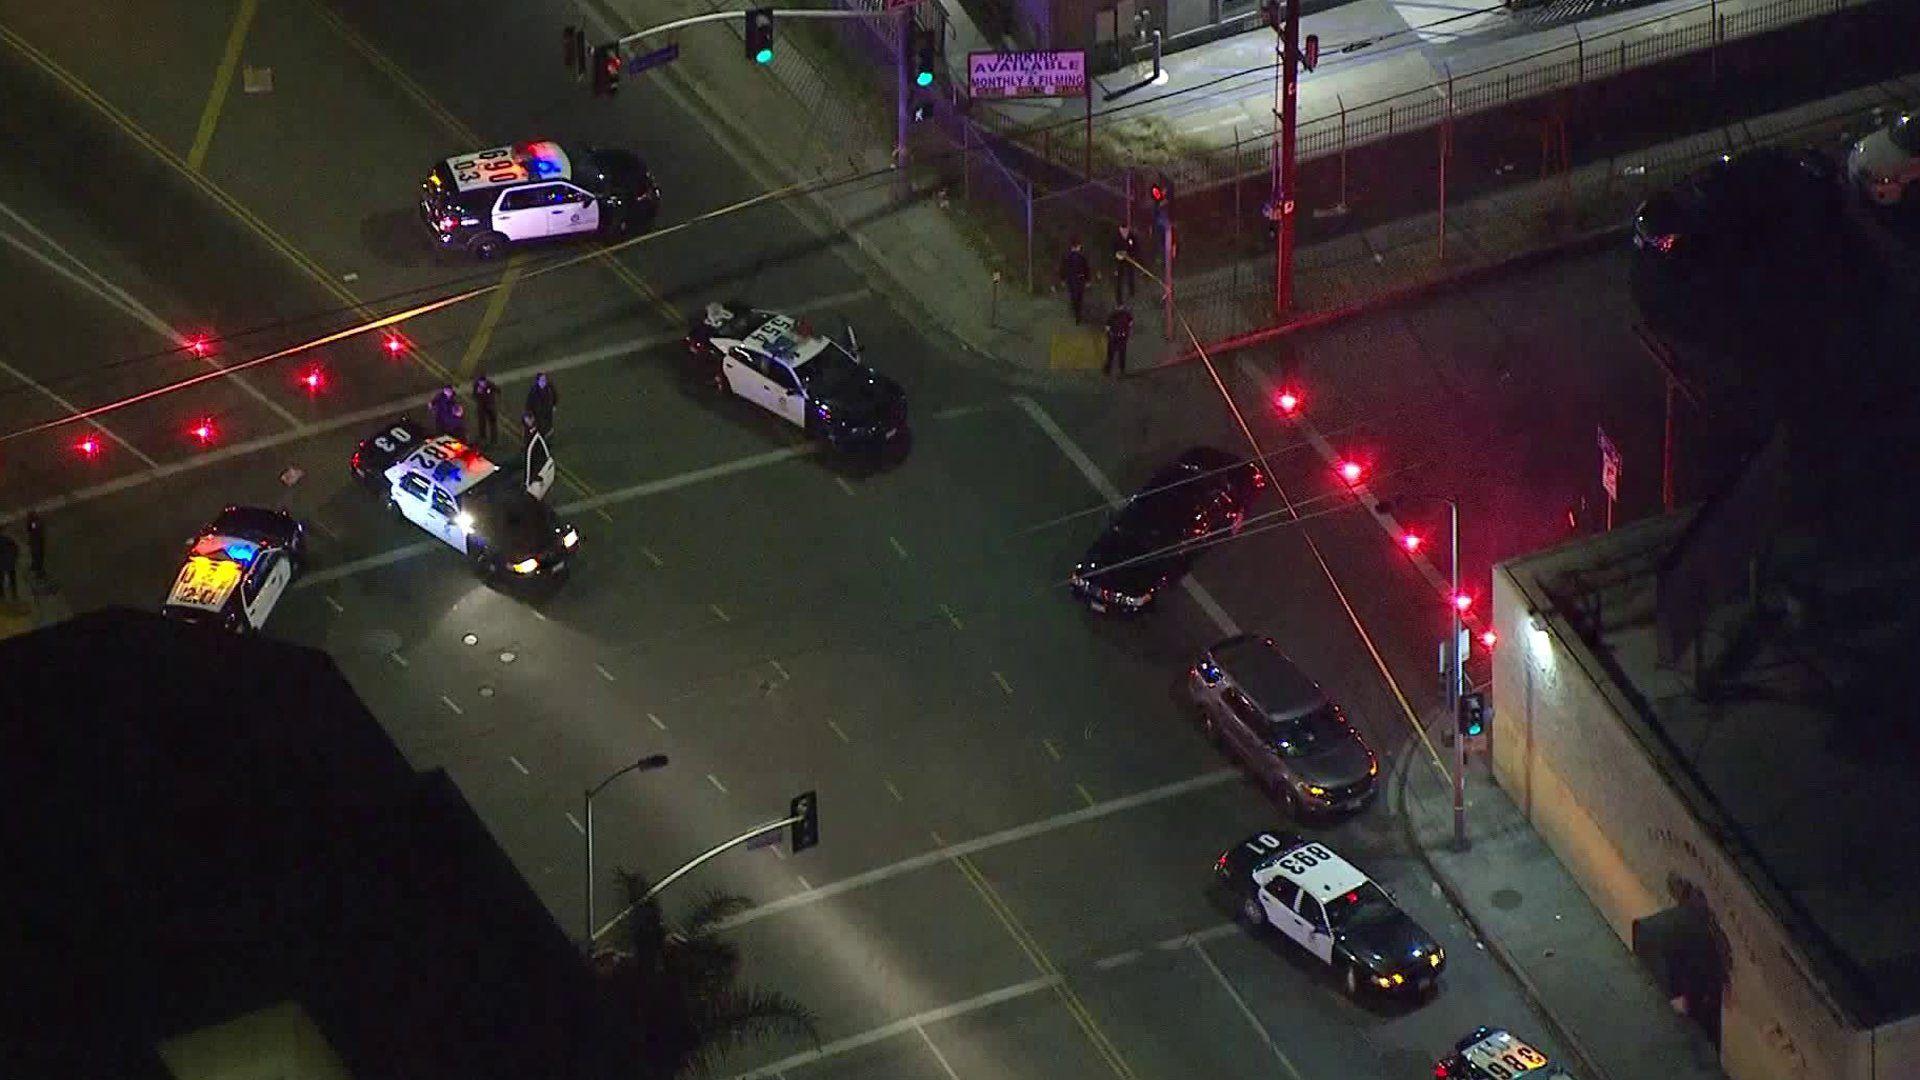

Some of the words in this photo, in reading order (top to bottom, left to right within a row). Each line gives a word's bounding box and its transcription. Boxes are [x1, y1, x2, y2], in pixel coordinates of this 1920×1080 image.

[975, 61, 1079, 73] AVAILABLE
[997, 52, 1058, 62] PARKING
[972, 76, 1024, 88] MONTHLY
[1039, 75, 1084, 87] FILMING
[454, 161, 481, 181] 03
[479, 149, 517, 182] 690
[375, 427, 411, 452] 03
[1246, 834, 1280, 855] 01
[1280, 846, 1331, 875] 893
